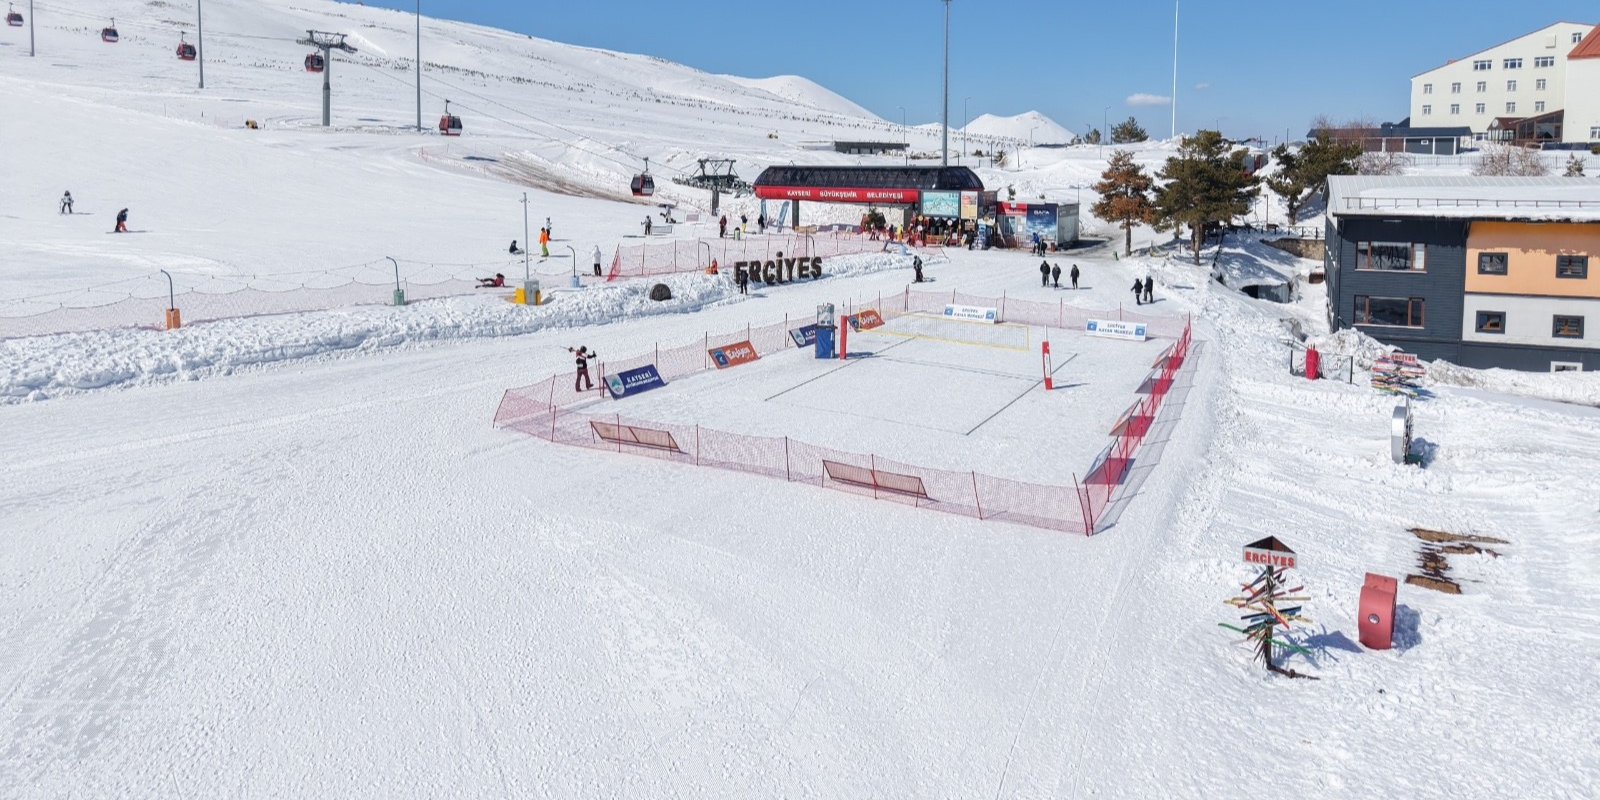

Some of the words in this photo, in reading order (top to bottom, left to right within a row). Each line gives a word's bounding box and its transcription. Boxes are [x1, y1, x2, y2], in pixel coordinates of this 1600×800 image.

[787, 189, 811, 197] KAYSERİ
[866, 191, 904, 199] BELEDİYESİ
[1245, 550, 1295, 568] ERCİYES
